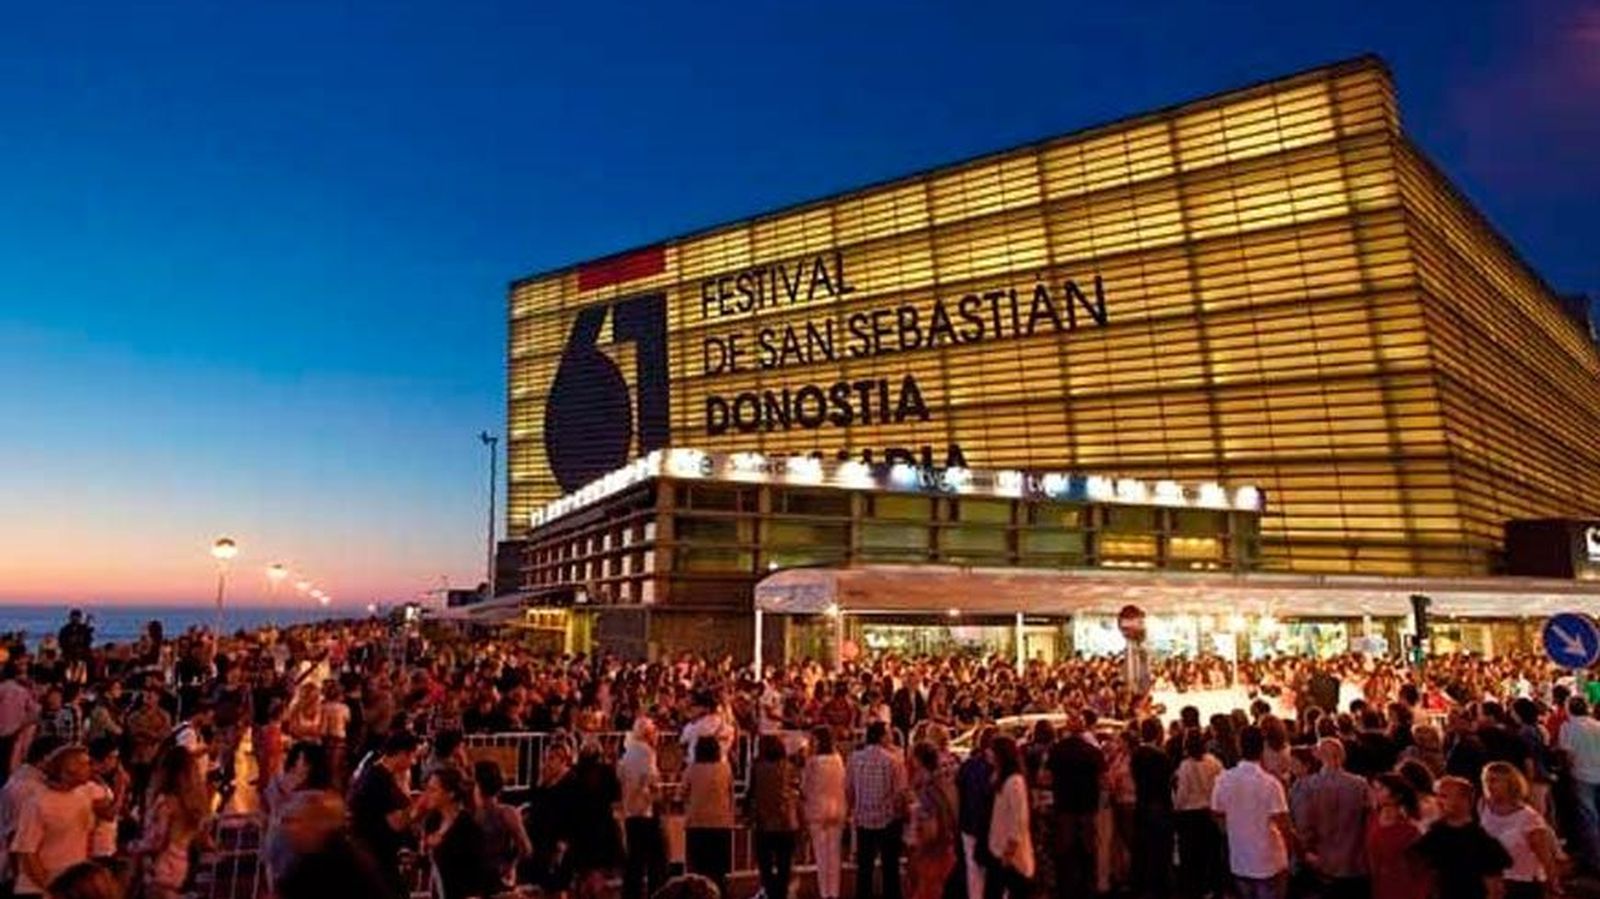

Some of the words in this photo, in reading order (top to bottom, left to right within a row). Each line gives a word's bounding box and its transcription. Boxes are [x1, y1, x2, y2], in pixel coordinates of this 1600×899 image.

[701, 251, 855, 319] FESTIVAL
[704, 334, 752, 377] DE
[758, 317, 840, 369] SAN
[848, 273, 1109, 357] SEBASTIÁN
[544, 291, 670, 494] 61
[705, 373, 930, 436] DONOSTIA
